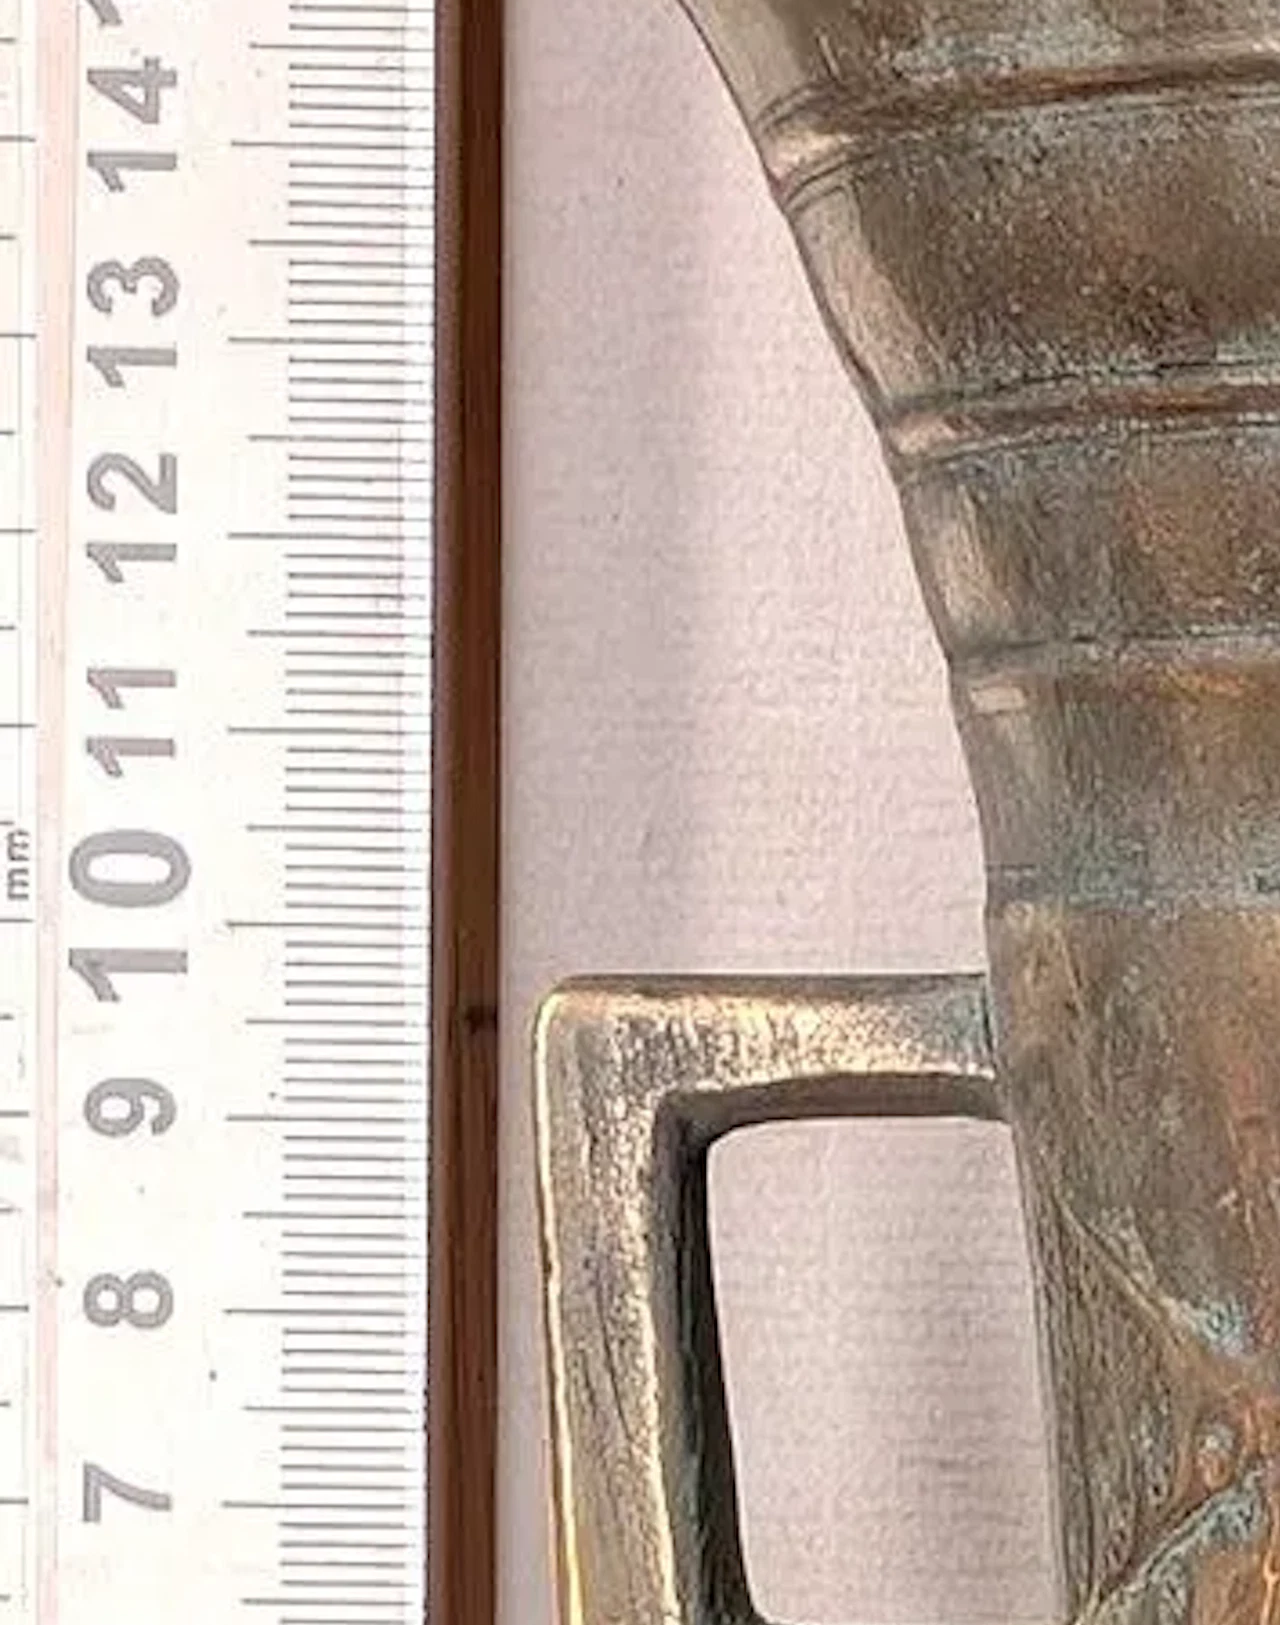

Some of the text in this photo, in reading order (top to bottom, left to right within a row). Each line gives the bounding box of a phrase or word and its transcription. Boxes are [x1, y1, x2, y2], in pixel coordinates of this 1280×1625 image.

[86, 57, 178, 192] 14
[86, 256, 180, 388] 13
[86, 453, 177, 584] 12
[85, 668, 177, 778] 11
[7, 829, 30, 901] mm
[68, 830, 192, 1003] 10
[83, 1078, 177, 1139] 9
[83, 1270, 174, 1330] 8
[82, 1461, 173, 1524] 7
